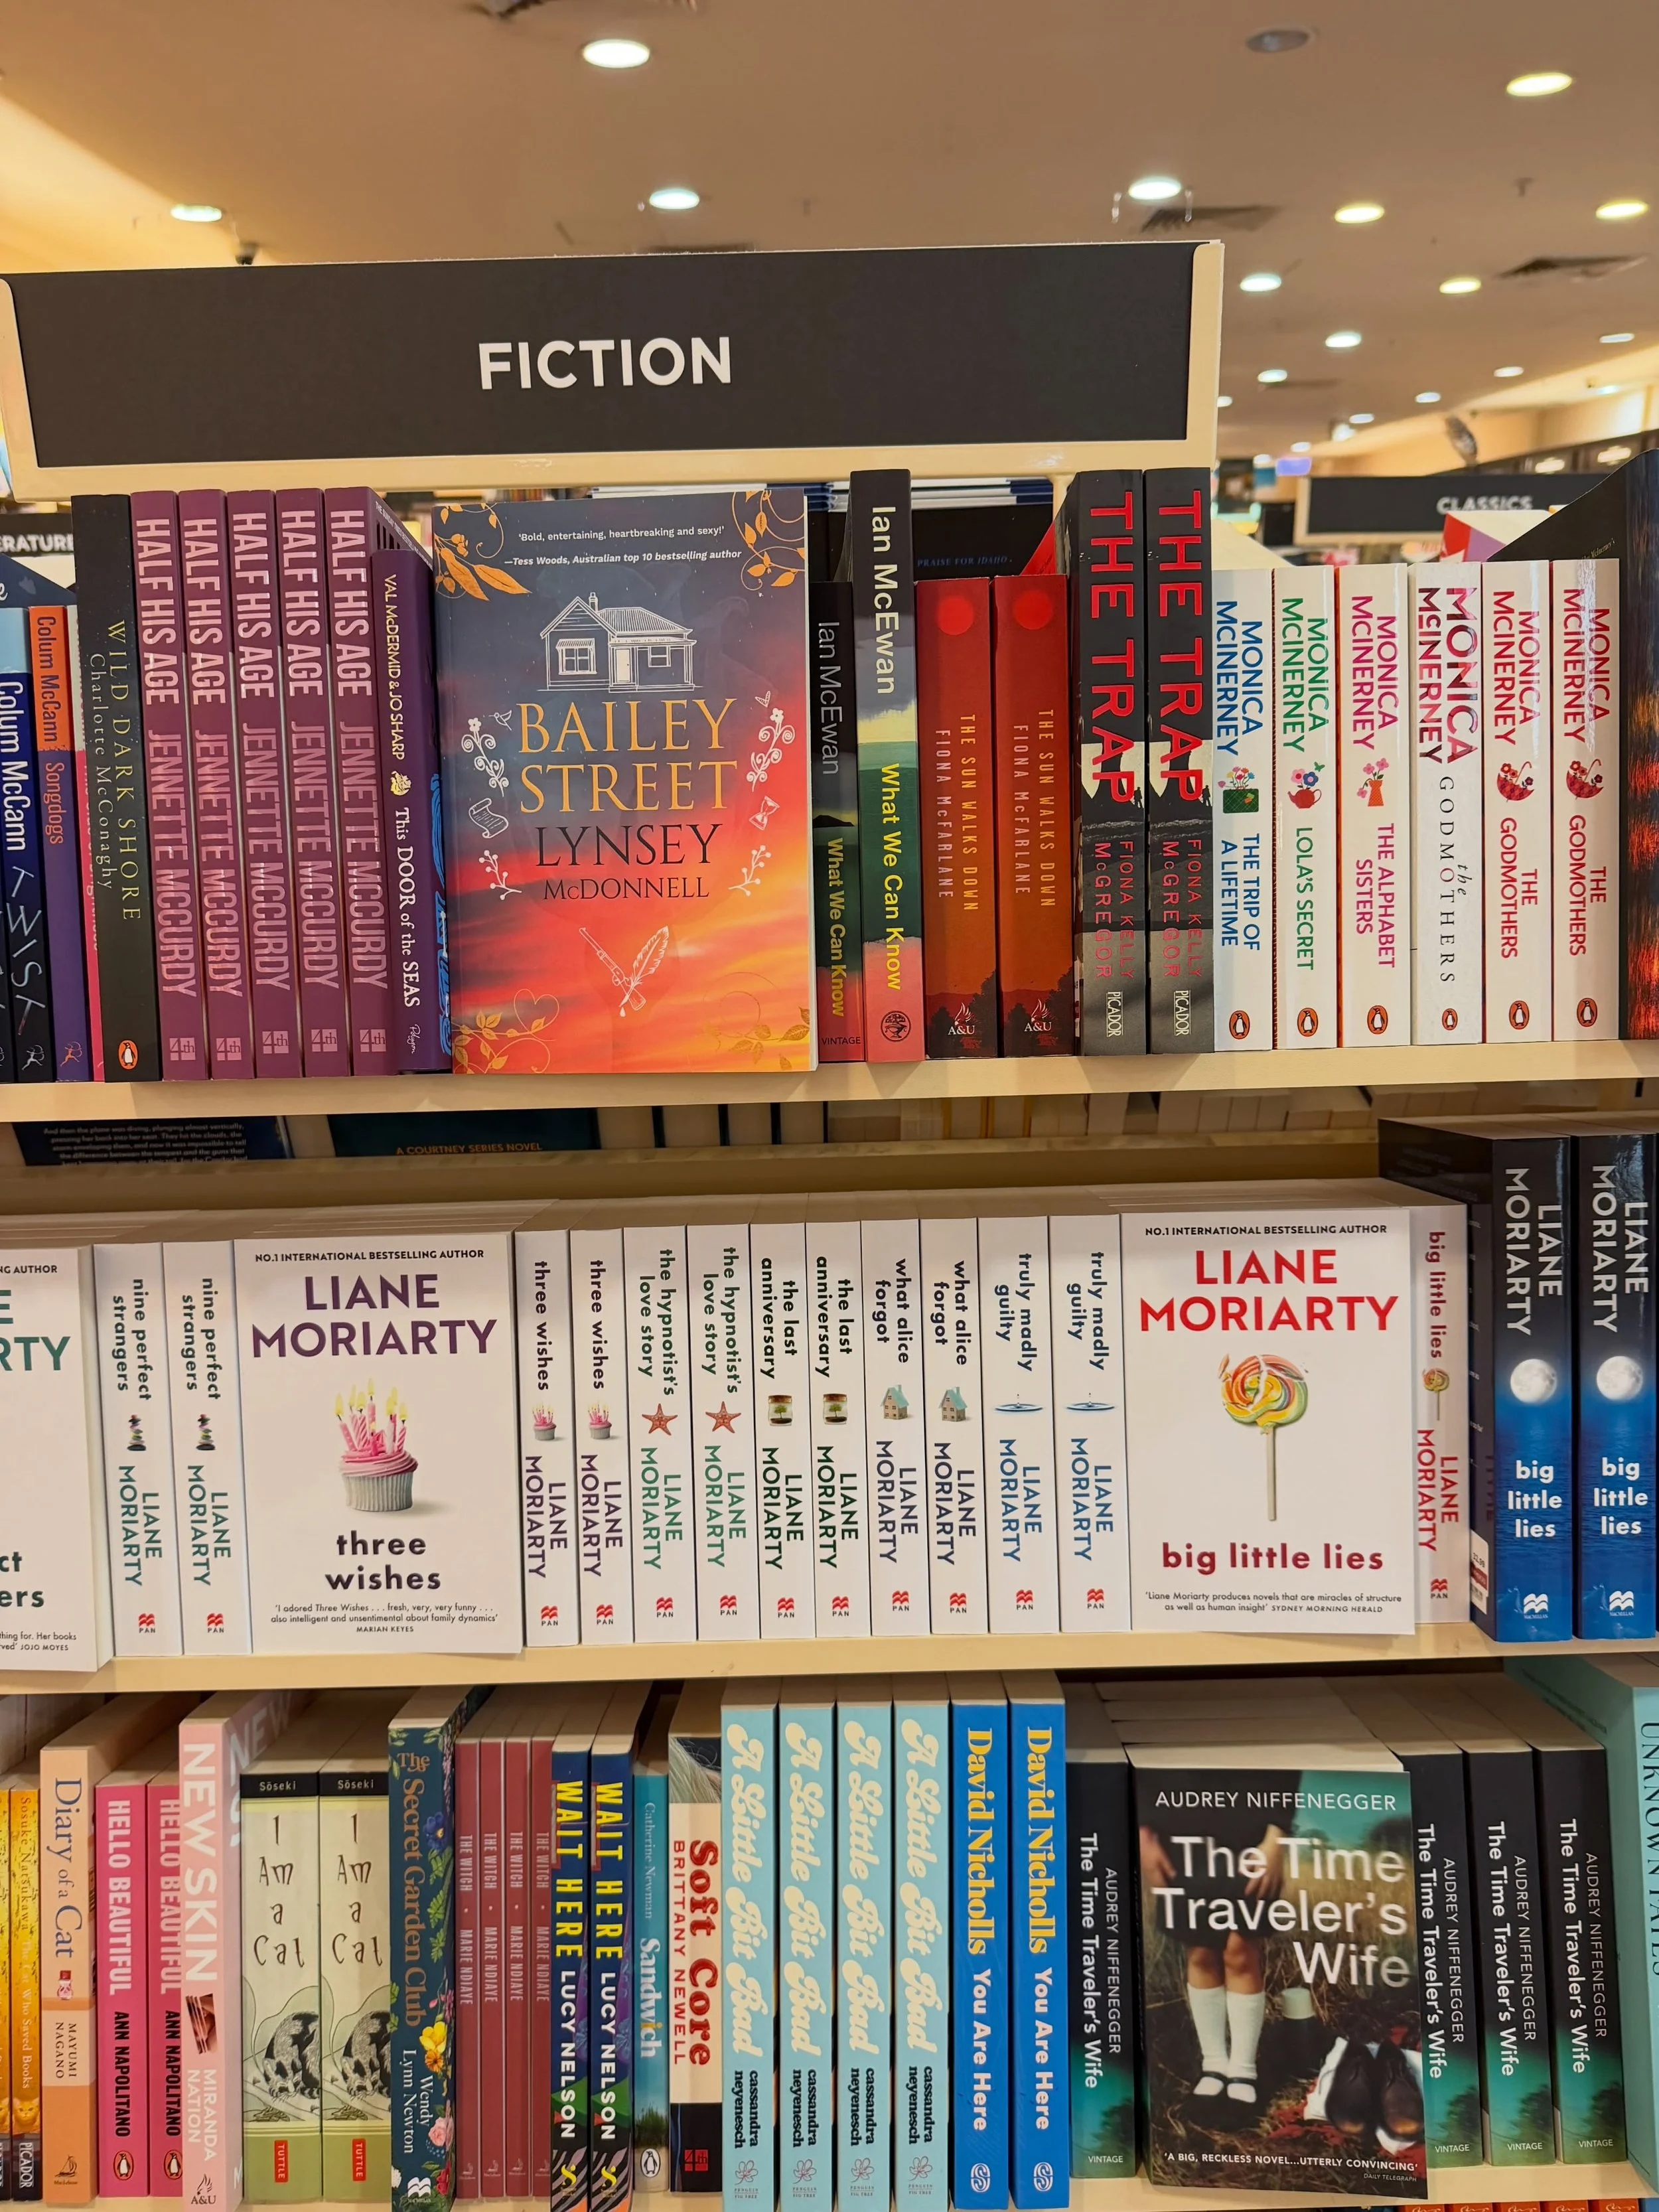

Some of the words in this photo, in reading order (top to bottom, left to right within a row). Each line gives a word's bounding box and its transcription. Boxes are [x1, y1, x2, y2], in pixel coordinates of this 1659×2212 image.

[478, 336, 733, 391] FICTION
[872, 506, 896, 552] Ian
[1437, 495, 1533, 514] CLASSICS
[233, 513, 269, 585] HALF
[548, 531, 606, 541] entertaining,
[609, 528, 674, 538] heartbreaking
[677, 527, 694, 536] and
[697, 526, 725, 536] sexy!'
[573, 554, 620, 563] Australian
[624, 553, 639, 563] top
[655, 551, 707, 561] bestselling
[710, 550, 742, 559] author
[1091, 491, 1134, 619] THE
[385, 574, 397, 602] VAL
[36, 617, 56, 668] Colum
[236, 592, 271, 642] HIS
[386, 605, 401, 678] McDERMID
[874, 564, 899, 694] McEwan
[108, 620, 129, 701] WILD
[239, 646, 275, 698] AGE
[1216, 601, 1238, 756] MCINERNEY
[1242, 621, 1263, 735] MONICA
[38, 674, 61, 741] McCann
[90, 652, 106, 757] Charlotte
[390, 692, 402, 711] JO
[517, 698, 737, 753] BAILEY
[1092, 638, 1135, 802] TRAP
[391, 713, 404, 760] SHARP
[960, 714, 975, 745] THE
[113, 715, 135, 802] DARK
[936, 730, 951, 783] FIONA
[961, 757, 976, 788] SUN
[44, 763, 65, 845] Songdogs
[243, 723, 283, 854] JENNETTE
[521, 761, 737, 813] STREET
[881, 763, 900, 824] What
[96, 765, 113, 889] McConaghy
[396, 807, 409, 840] This
[536, 824, 723, 866] LYNSEY
[883, 832, 902, 867] We
[937, 796, 953, 897] McFARLANE
[962, 801, 977, 854] WALKS
[1221, 840, 1238, 855] A
[1377, 823, 1394, 859] THE
[119, 818, 141, 921] SHORE
[397, 846, 415, 909] DOOR
[1119, 840, 1133, 904] FIONA
[1243, 834, 1259, 869] THE
[1296, 828, 1313, 894] LOLA'S
[543, 877, 709, 901] McDONNELL
[884, 875, 903, 919] Can
[964, 867, 978, 911] DOWN
[1095, 843, 1112, 978] McGREGOR
[1221, 861, 1238, 946] LIFETIME
[1243, 877, 1260, 919] TRIP
[1356, 859, 1373, 934] SISTERS
[249, 863, 291, 991] MCCURDY
[401, 913, 414, 928] of
[1244, 924, 1260, 950] OF
[1297, 900, 1314, 970] SECRET
[1378, 868, 1396, 968] ALPHABET
[402, 933, 415, 956] the
[886, 927, 904, 990] Know
[1120, 915, 1134, 978] KELLY
[403, 961, 420, 1007] SEAS
[948, 1025, 975, 1035] A&U
[1108, 992, 1123, 1037] PICADOR
[821, 1037, 861, 1045] VINTAGE
[407, 1145, 465, 1154] COURTNEY
[469, 1144, 504, 1153] SERIES
[506, 1142, 543, 1151] NOVEL
[281, 1252, 366, 1262] INTERNATIONAL
[369, 1250, 437, 1259] BESTSELLING
[440, 1250, 484, 1258] AUTHOR
[133, 1278, 145, 1322] nine
[305, 1274, 440, 1311] LIANE
[112, 1295, 128, 1390] strangers
[132, 1327, 152, 1400] perfect
[252, 1319, 498, 1358] MORIARTY
[119, 1465, 143, 1586] MORIARTY
[142, 1493, 162, 1559] LIANE
[336, 1530, 426, 1556] three
[325, 1564, 441, 1591] wishes
[1162, 1542, 1216, 1576] big
[1230, 1542, 1309, 1570] little
[1324, 1543, 1384, 1570] lies
[1173, 1593, 1210, 1601] Moriarty
[1212, 1593, 1250, 1602] produces
[1238, 1603, 1268, 1613] insight'
[1027, 1727, 1056, 1820] David
[47, 1777, 82, 1863] Diary
[556, 1781, 583, 1858] WAIT
[1155, 1791, 1238, 1808] AUDREY
[1248, 1792, 1396, 1811] NIFFENEGGER
[273, 1815, 281, 1845] I
[59, 1869, 74, 1887] of
[259, 1856, 293, 1885] Am
[1171, 1835, 1267, 1880] The
[1275, 1837, 1406, 1883] Time
[273, 1902, 283, 1924] a
[673, 1840, 685, 1956] BRITTANY
[689, 1840, 719, 1937] Soft
[1029, 1827, 1056, 1954] Nicholls
[1151, 1887, 1407, 1935] Traveler's
[55, 1903, 82, 1958] Cat
[556, 1878, 583, 1957] HERE
[253, 1935, 305, 1968] Cat
[1293, 1941, 1410, 1988] Wife
[561, 1970, 576, 2035] LUCY
[674, 1969, 686, 2065] NEWELL
[689, 1958, 719, 2066] Core
[1034, 1968, 1053, 2014] You
[55, 2023, 65, 2079] NAGANO
[68, 2023, 77, 2077] MAYUMI
[1035, 2022, 1054, 2064] Are
[561, 2043, 576, 2139] NELSON
[1036, 2073, 1050, 2130] Here
[277, 2143, 286, 2179] TUTTLE
[1202, 2154, 1251, 2163] RECKLESS
[1346, 2159, 1417, 2171] CONVINCING'
